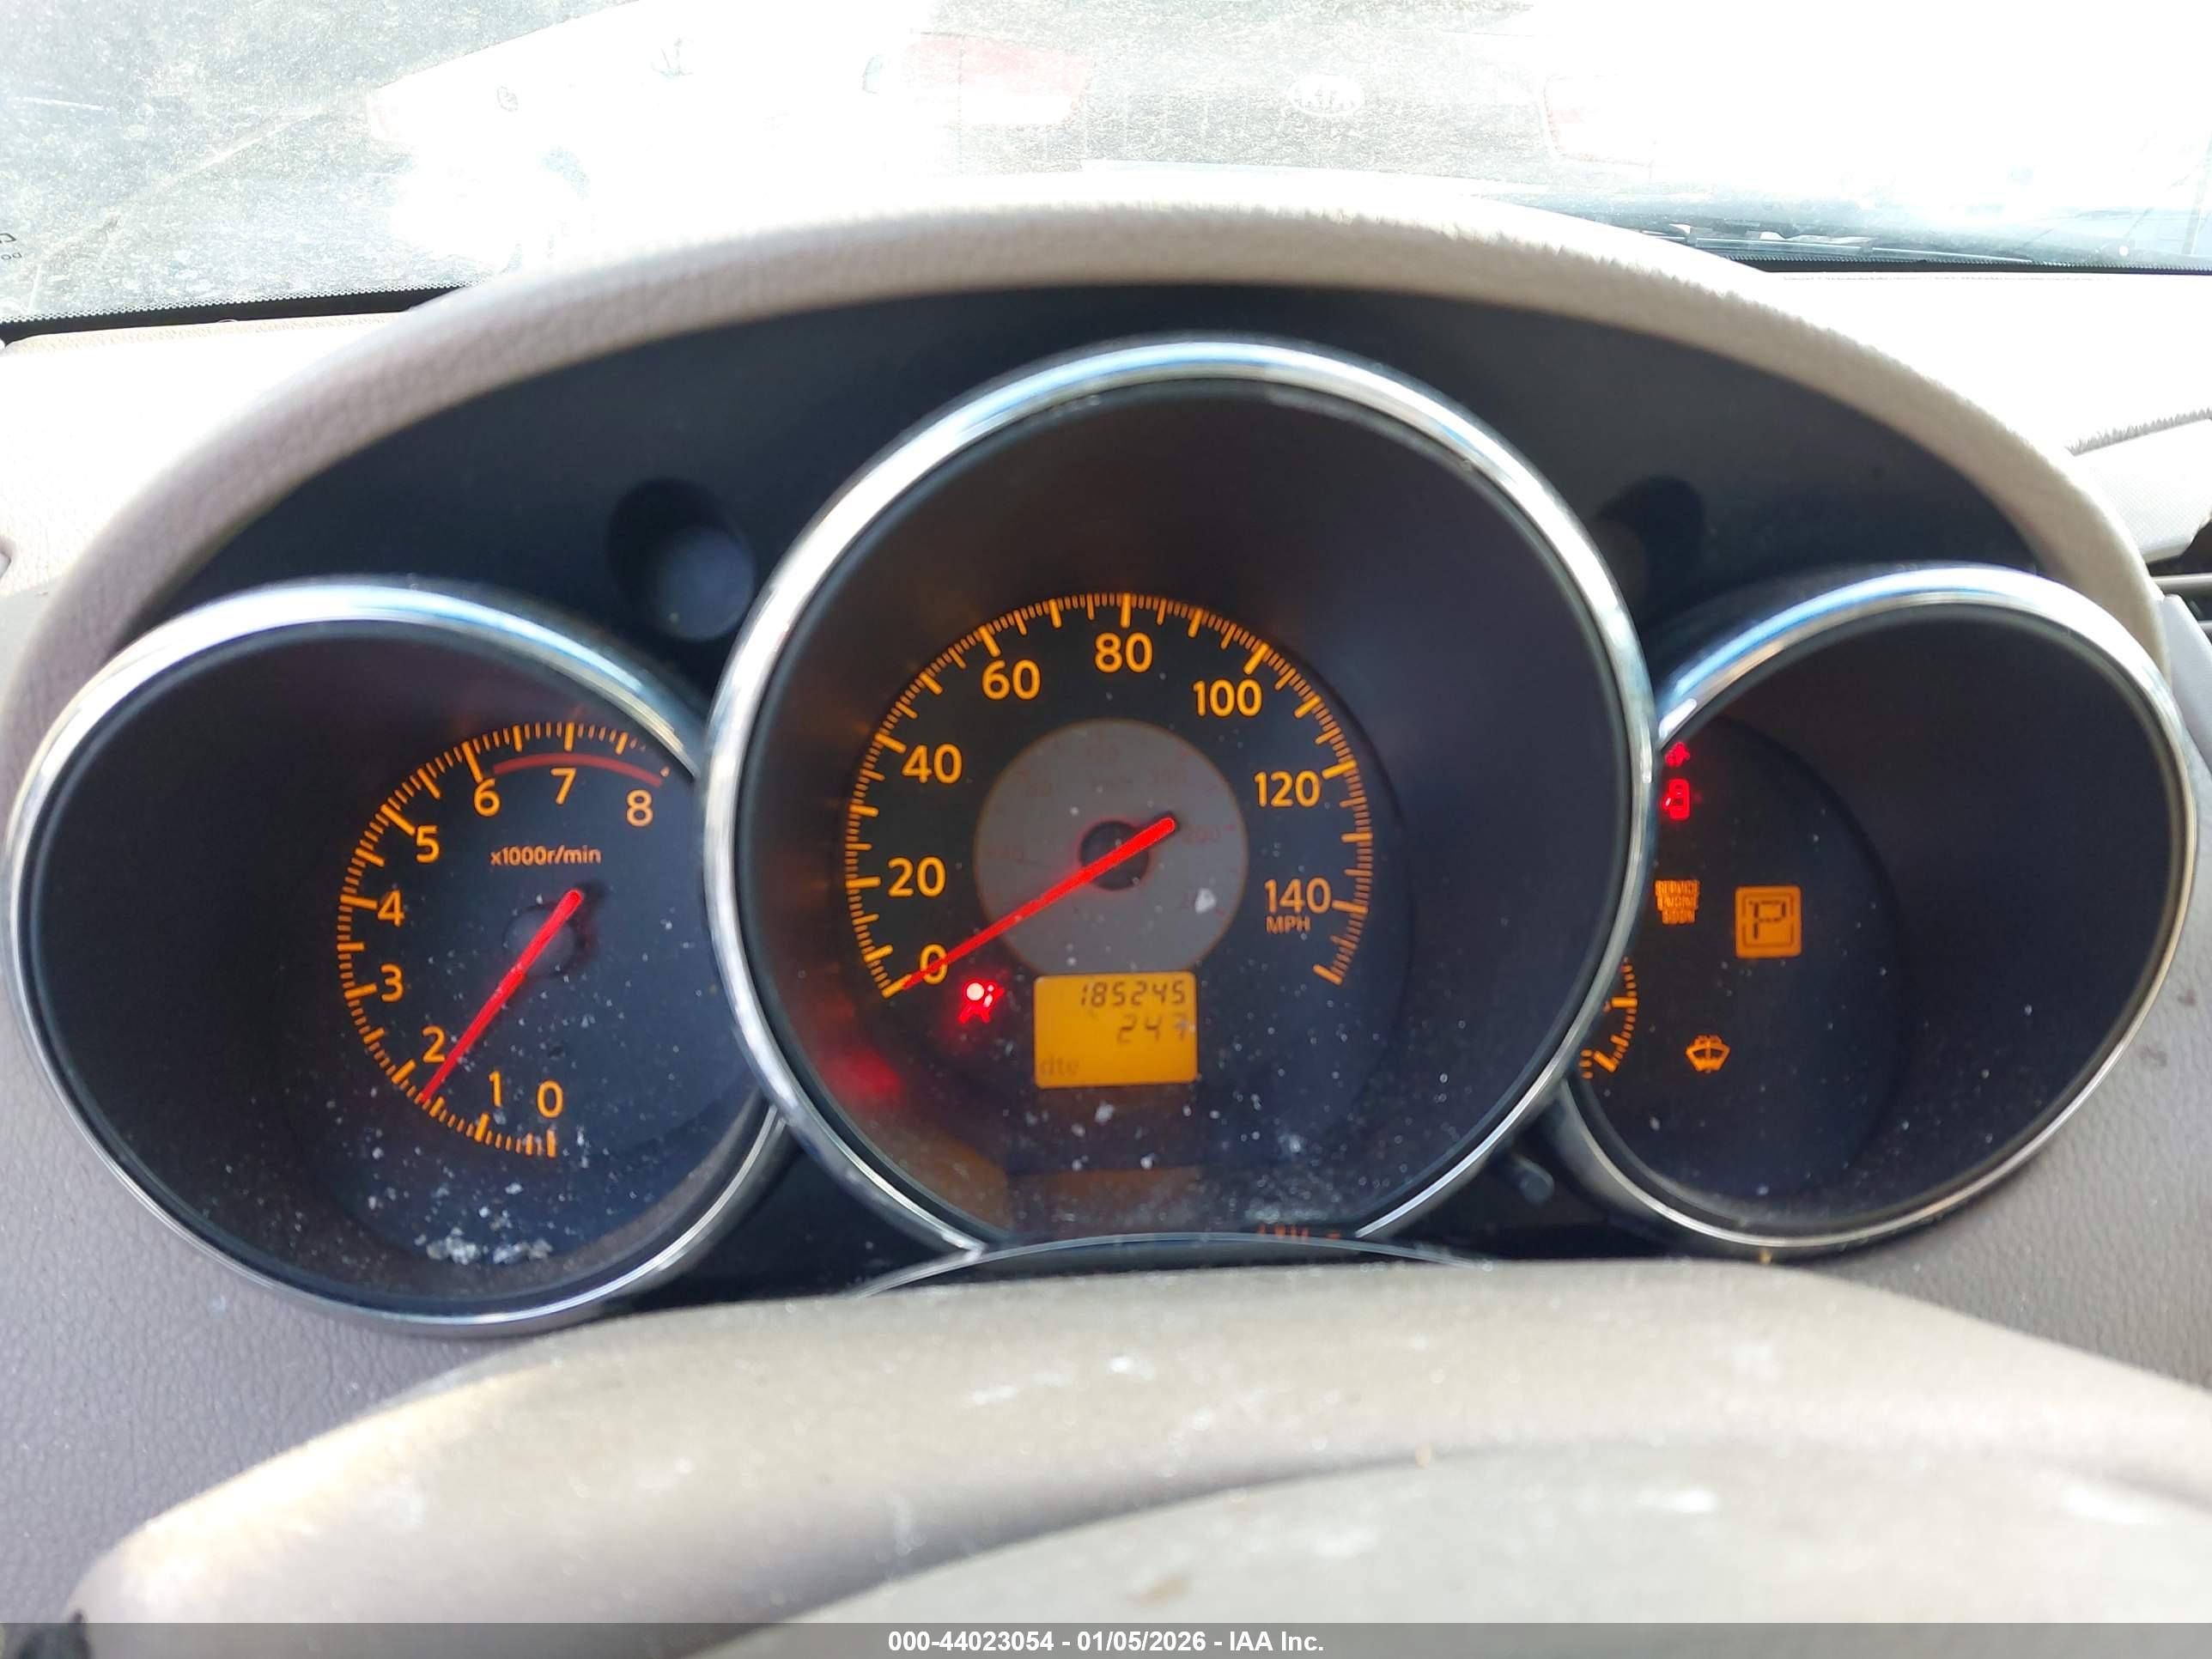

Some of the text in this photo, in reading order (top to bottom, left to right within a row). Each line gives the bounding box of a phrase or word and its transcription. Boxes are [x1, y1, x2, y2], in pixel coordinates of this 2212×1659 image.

[1095, 632, 1153, 672] 80
[981, 659, 1041, 700] 60
[1193, 679, 1262, 717] 100
[902, 744, 962, 783] 40
[473, 779, 501, 817] 6
[551, 768, 576, 804] 7
[1254, 770, 1321, 807] 120
[626, 789, 653, 827] 8
[416, 825, 440, 863] 5
[490, 845, 601, 866] x1000r/min
[887, 856, 945, 896] 20
[377, 890, 404, 927] 4
[1264, 877, 1332, 914] 140
[1266, 915, 1310, 934] MPH
[1749, 900, 1785, 939] P
[381, 963, 404, 1002] 3
[920, 944, 948, 984] 0
[1079, 980, 1187, 1007] 185245
[422, 1026, 446, 1063] 2
[1116, 1012, 1188, 1043] 247
[489, 1071, 501, 1107] 1
[537, 1079, 563, 1118] 0
